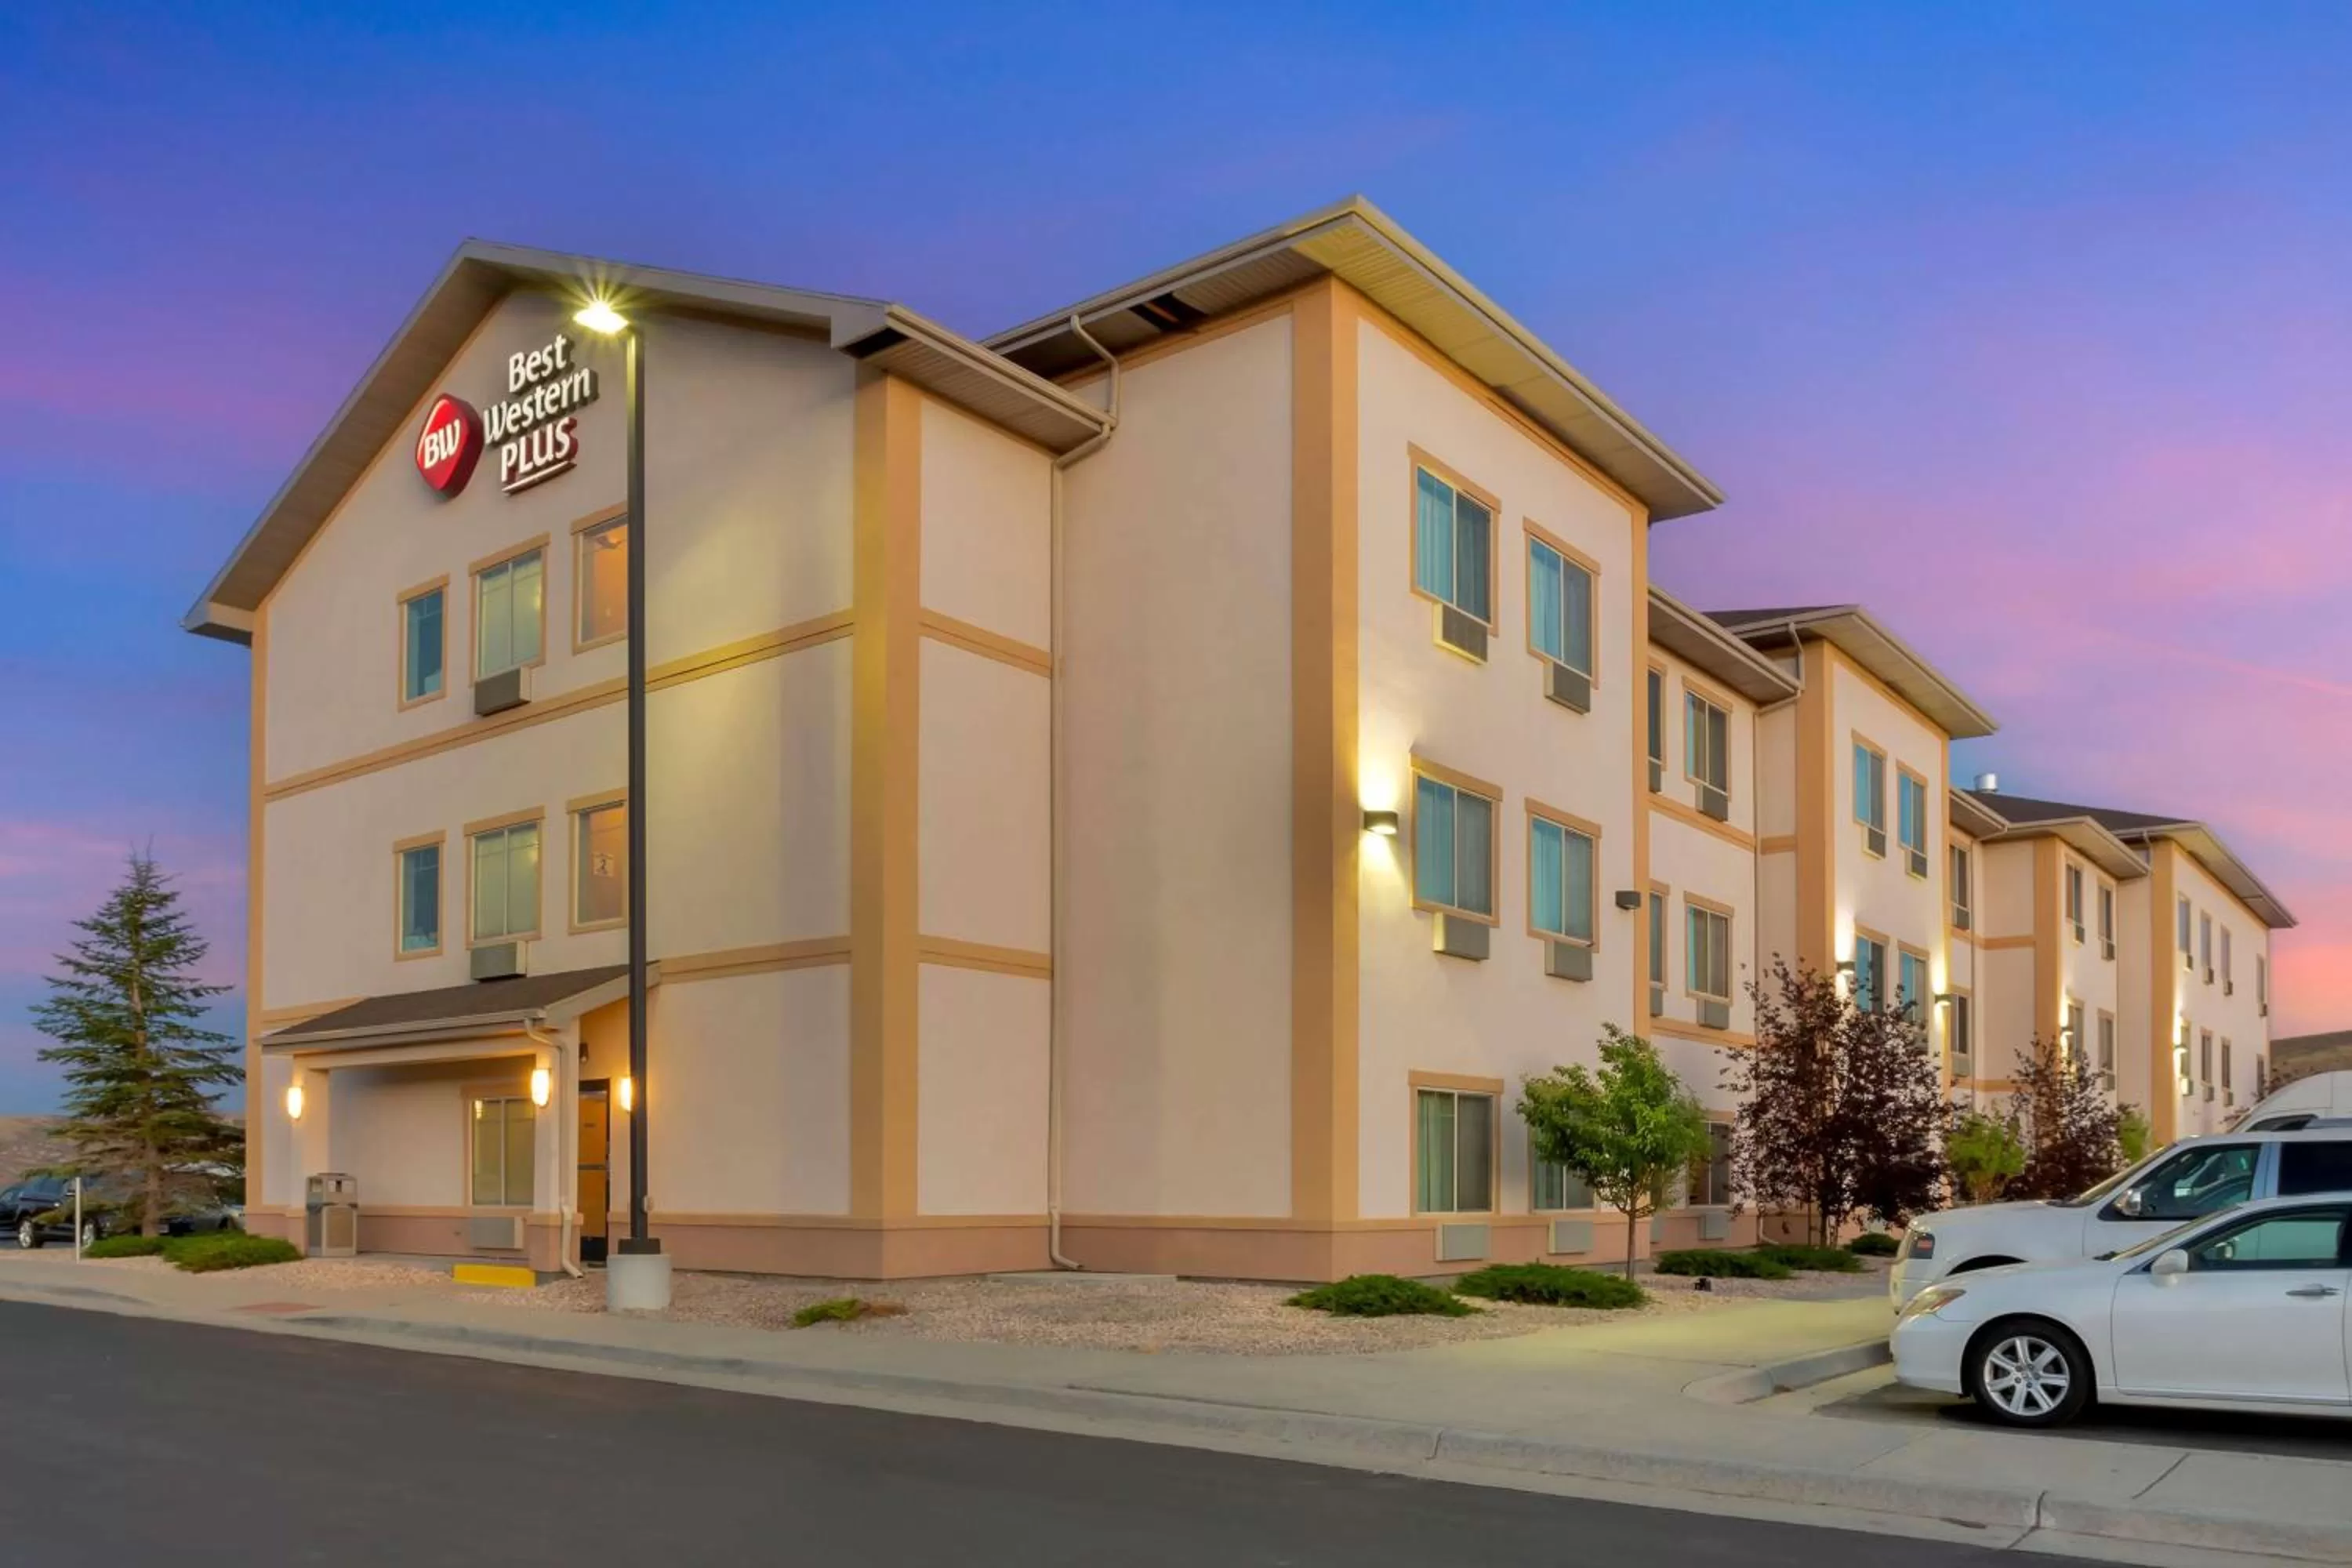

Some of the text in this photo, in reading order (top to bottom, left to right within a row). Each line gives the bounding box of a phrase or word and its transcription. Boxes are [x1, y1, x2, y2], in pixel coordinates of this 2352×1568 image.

[509, 334, 567, 392] Best
[483, 368, 590, 445] Western
[424, 418, 460, 469] BW
[501, 417, 571, 481] PLUS
